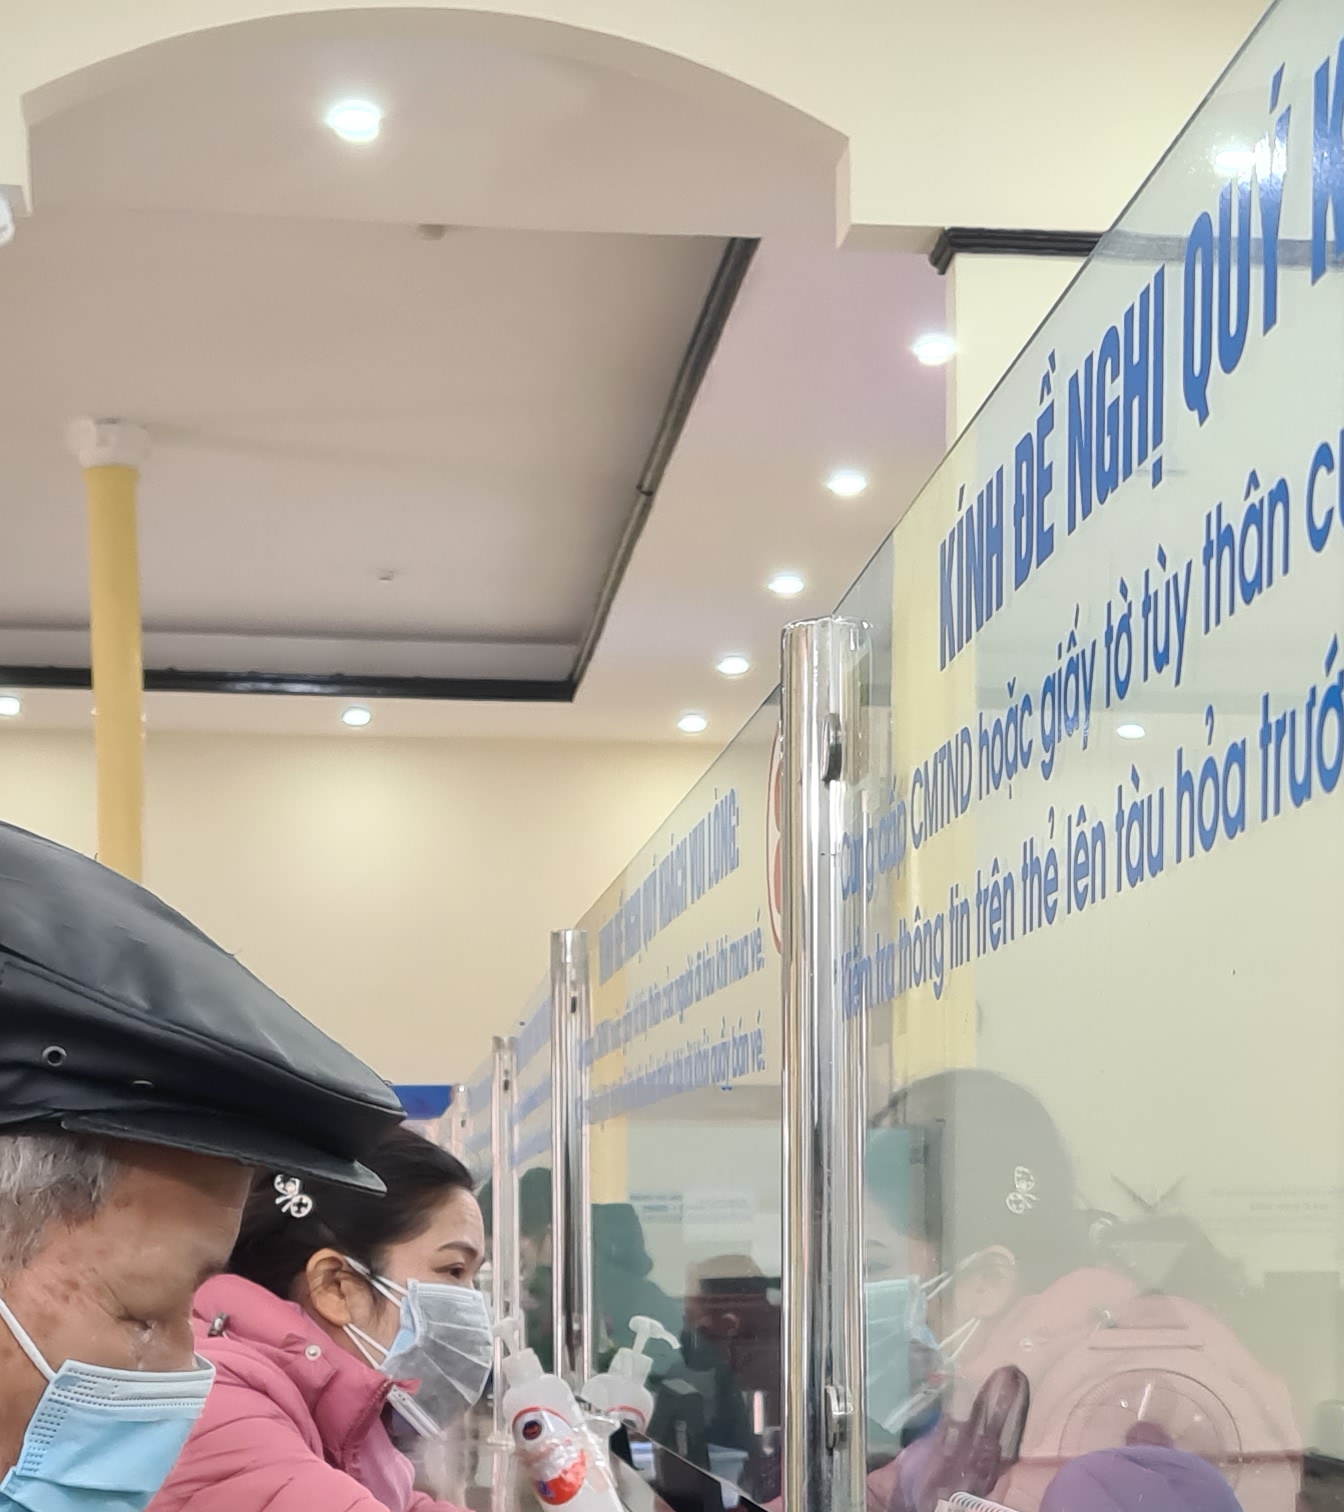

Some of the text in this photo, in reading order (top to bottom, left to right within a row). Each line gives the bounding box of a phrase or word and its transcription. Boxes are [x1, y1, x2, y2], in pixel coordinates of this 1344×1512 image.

[938, 483, 1004, 671] KÍNH
[1013, 350, 1056, 592] ĐỀ
[1067, 263, 1165, 537] NGHỊ
[1183, 62, 1291, 427] QUÝ
[910, 725, 973, 850] CMTND
[978, 676, 1033, 801] hoặc
[1040, 603, 1097, 781] giấy
[1104, 577, 1133, 709] tờ
[1141, 542, 1193, 687] tùy
[1202, 468, 1290, 636] thân
[898, 904, 945, 1001] thông
[948, 883, 971, 970] tin
[975, 857, 1016, 958] trên
[1022, 805, 1059, 936] thẻ
[1067, 804, 1107, 915] lên
[1115, 763, 1165, 893] tàu
[1174, 703, 1247, 865] hỏa
